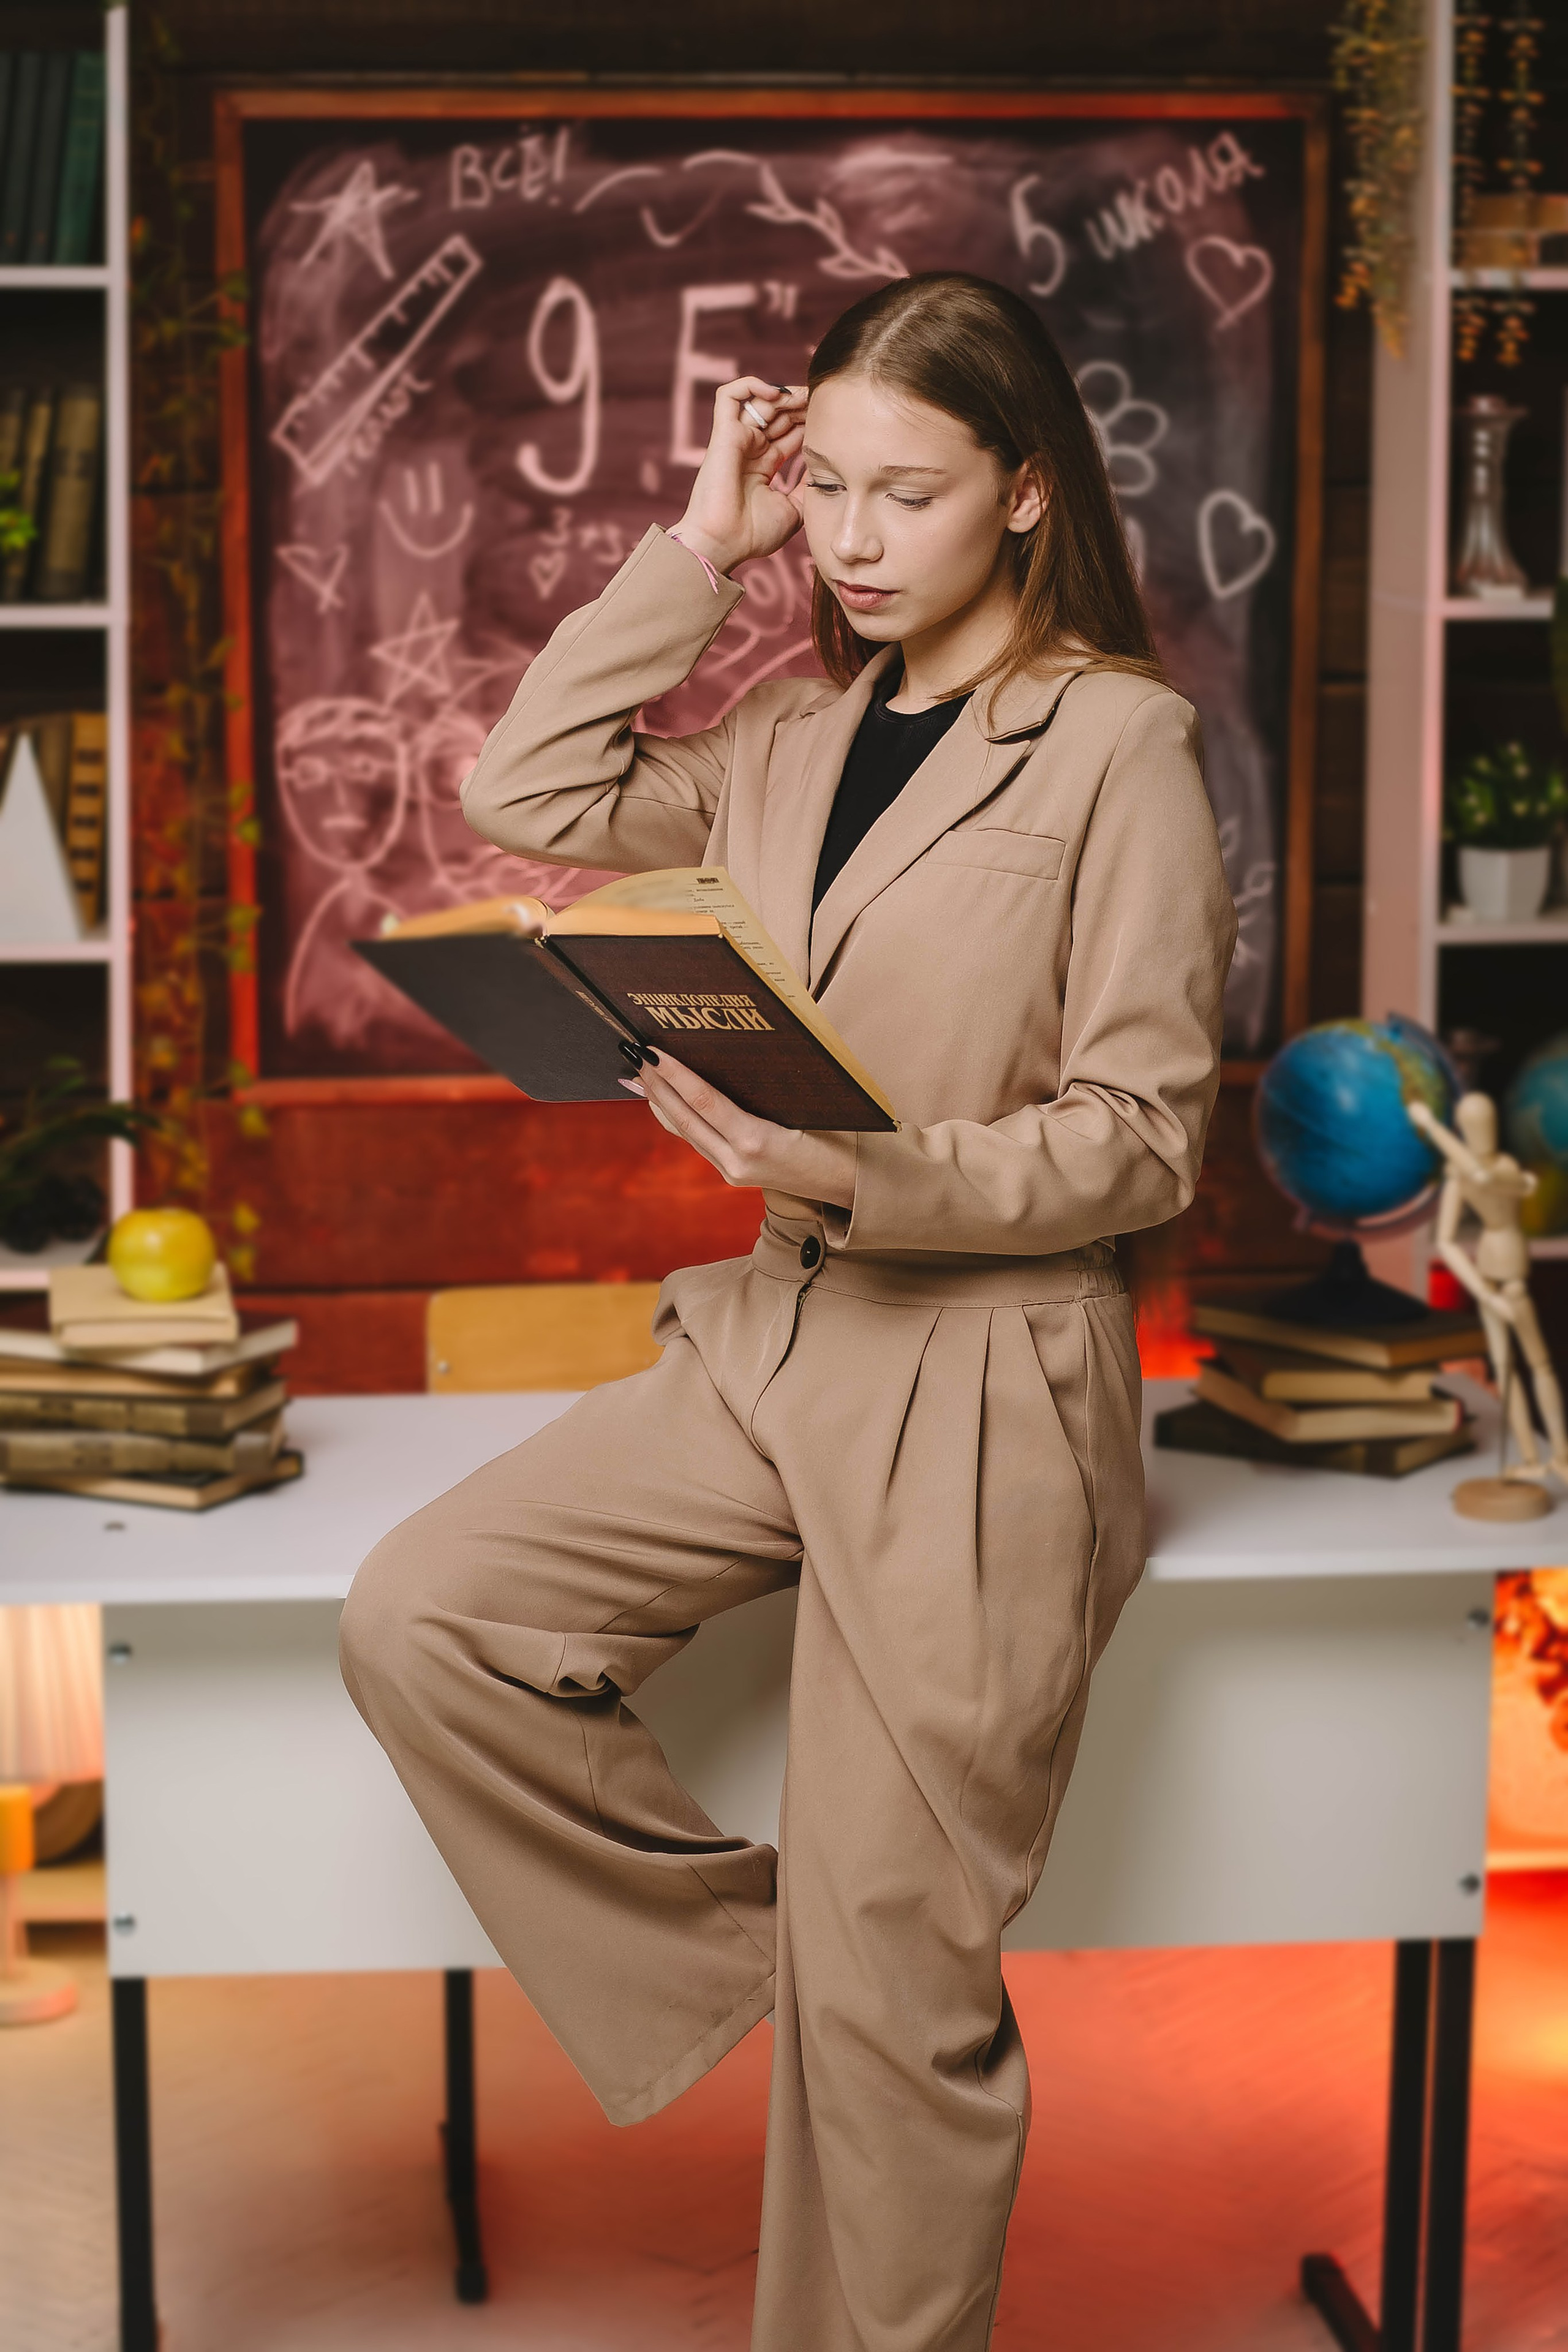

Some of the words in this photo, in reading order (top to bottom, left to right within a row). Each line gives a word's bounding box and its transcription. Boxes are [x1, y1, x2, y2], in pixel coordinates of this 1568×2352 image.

[517, 275, 601, 495] 9
[627, 992, 757, 1008] ЭНЦИКЛОПЕДИЯ
[644, 1006, 775, 1031] МЫСЛИ
